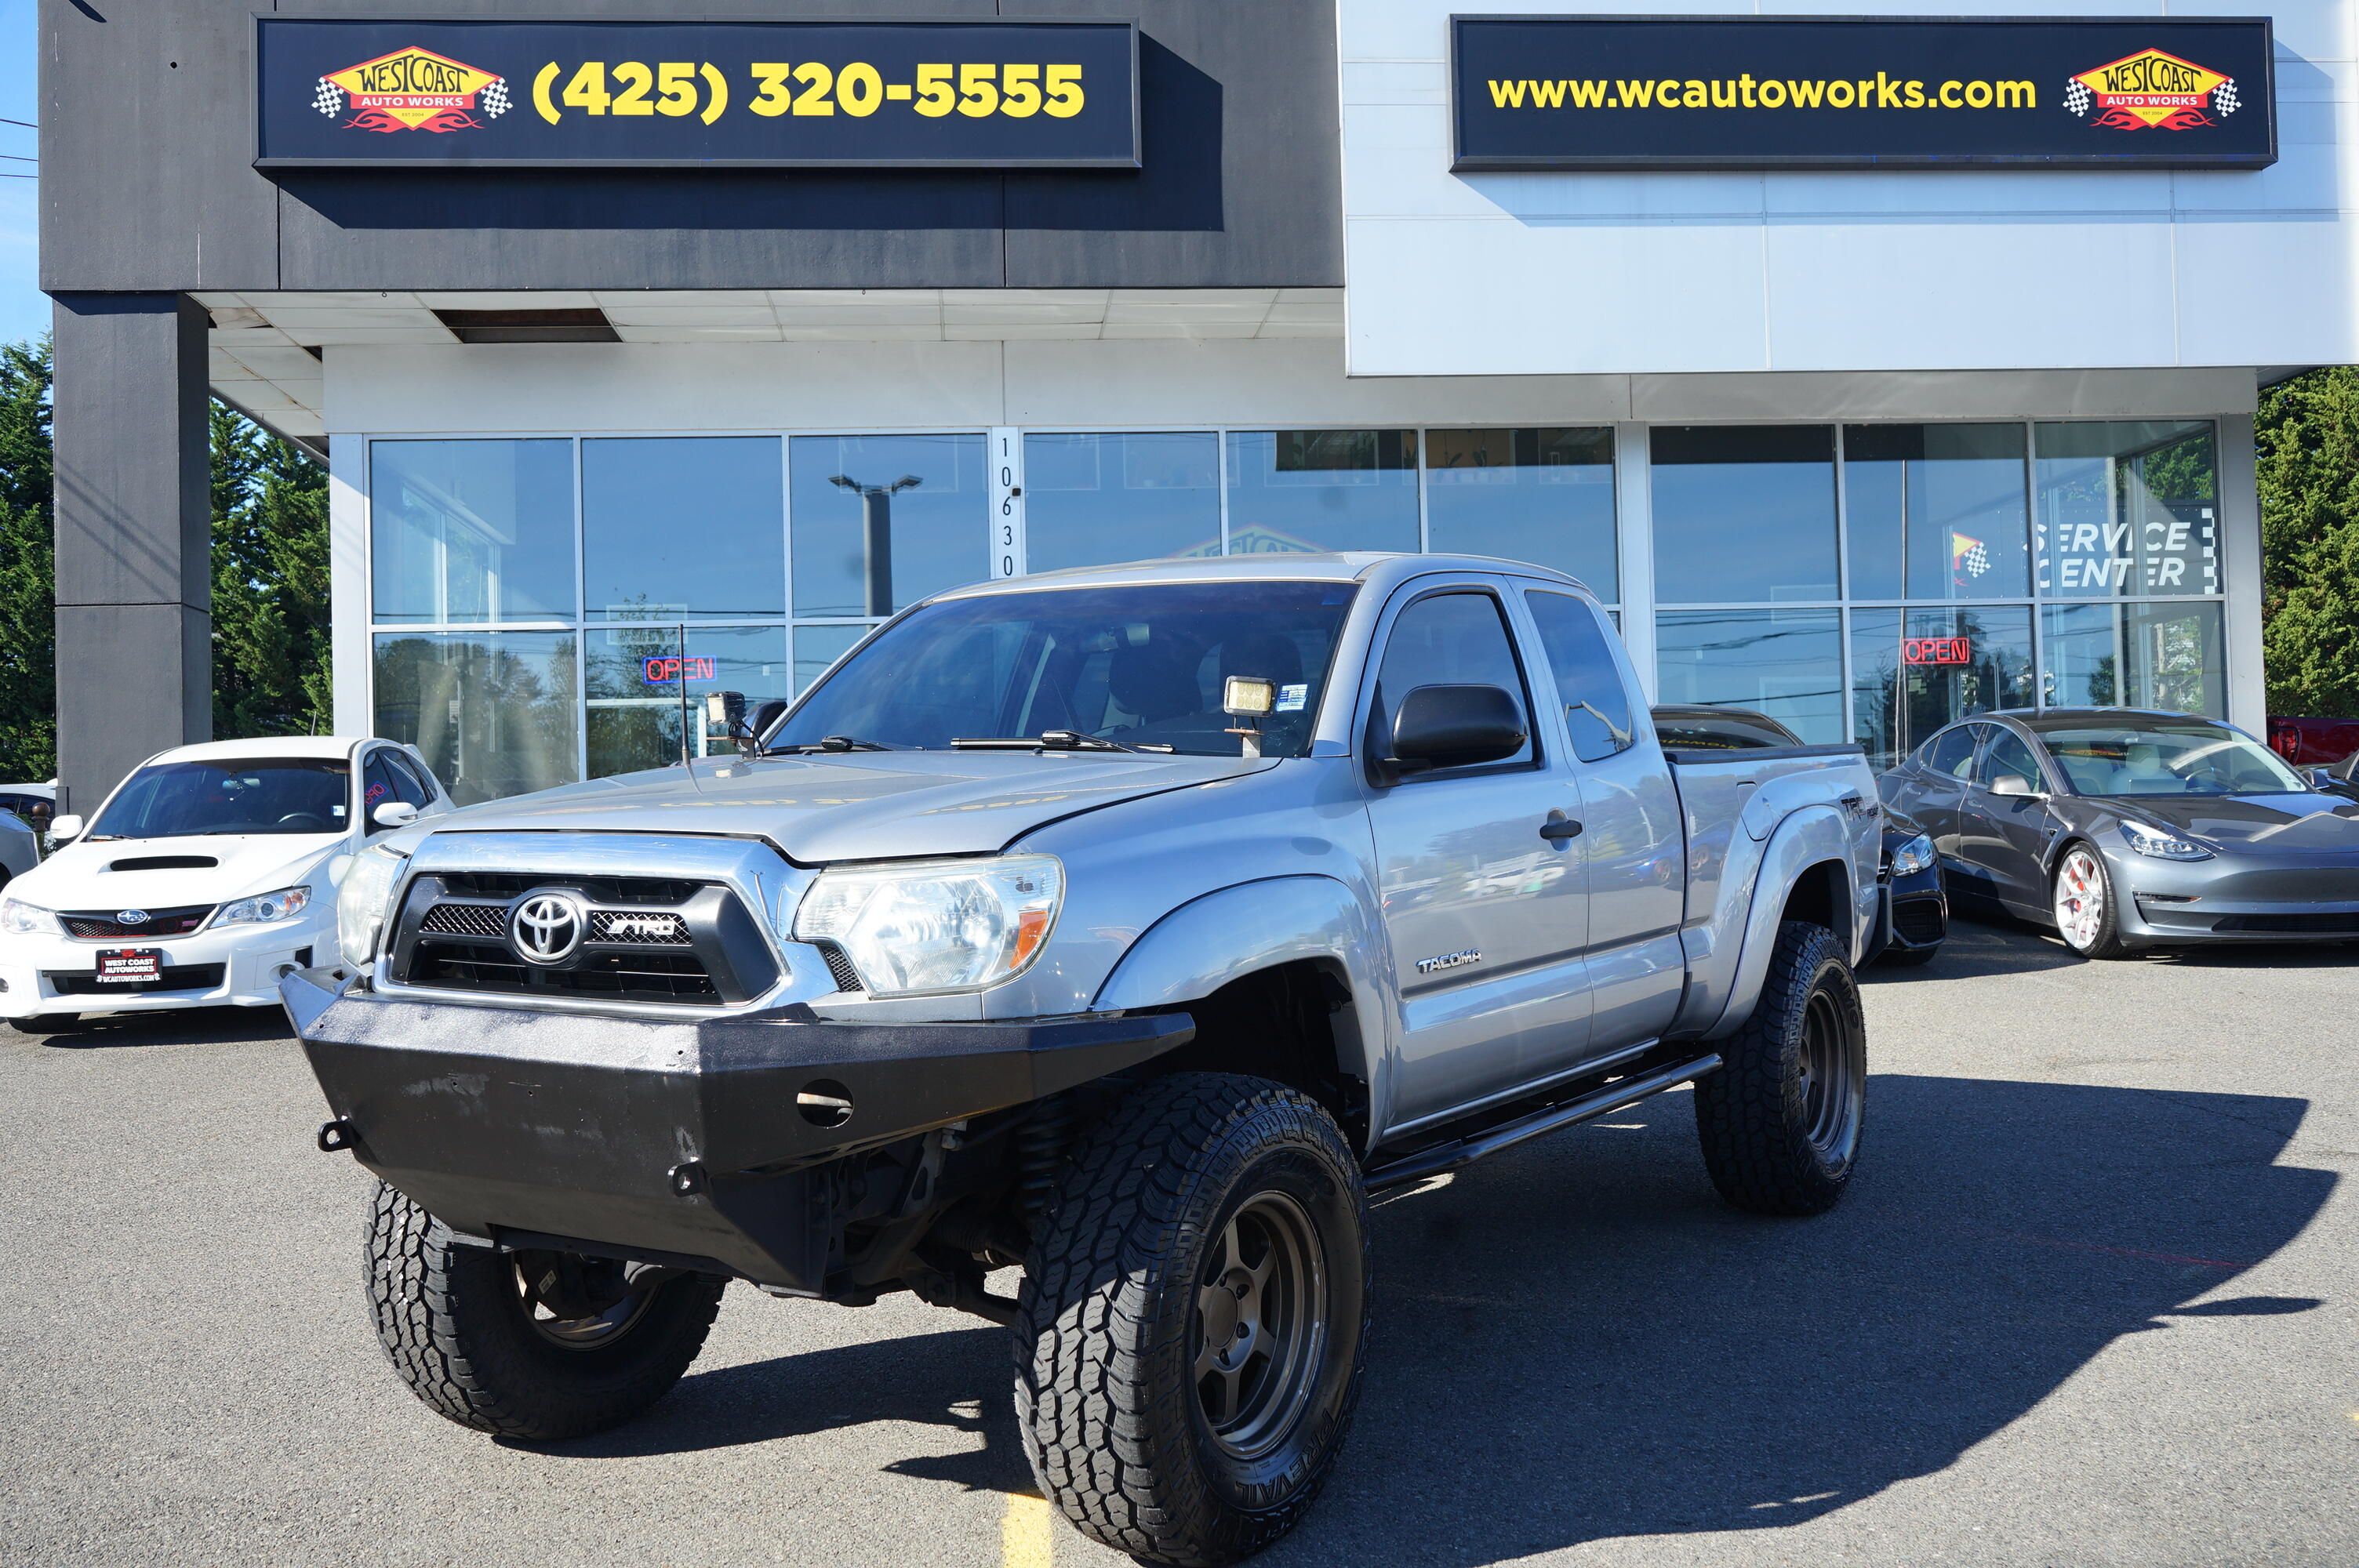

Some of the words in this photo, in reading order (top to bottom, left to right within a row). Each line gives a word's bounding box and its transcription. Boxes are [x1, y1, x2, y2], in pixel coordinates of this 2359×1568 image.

[362, 97, 404, 106] AUTO
[408, 96, 464, 106] WORKS
[533, 60, 728, 125] (425)
[748, 61, 1085, 118] 320-5555
[1488, 71, 2037, 108] www.wcautoworks.com
[2106, 96, 2145, 106] AUTO
[2147, 96, 2198, 106] WORKS
[2038, 557, 2186, 588] CENTER
[1905, 640, 1967, 662] OPEN
[647, 658, 714, 681] OPEN
[626, 920, 676, 935] TRD
[104, 965, 154, 974] AUTOWORKS
[1416, 948, 1482, 973] TACOMA
[1235, 1407, 1334, 1505] PREVAIL
